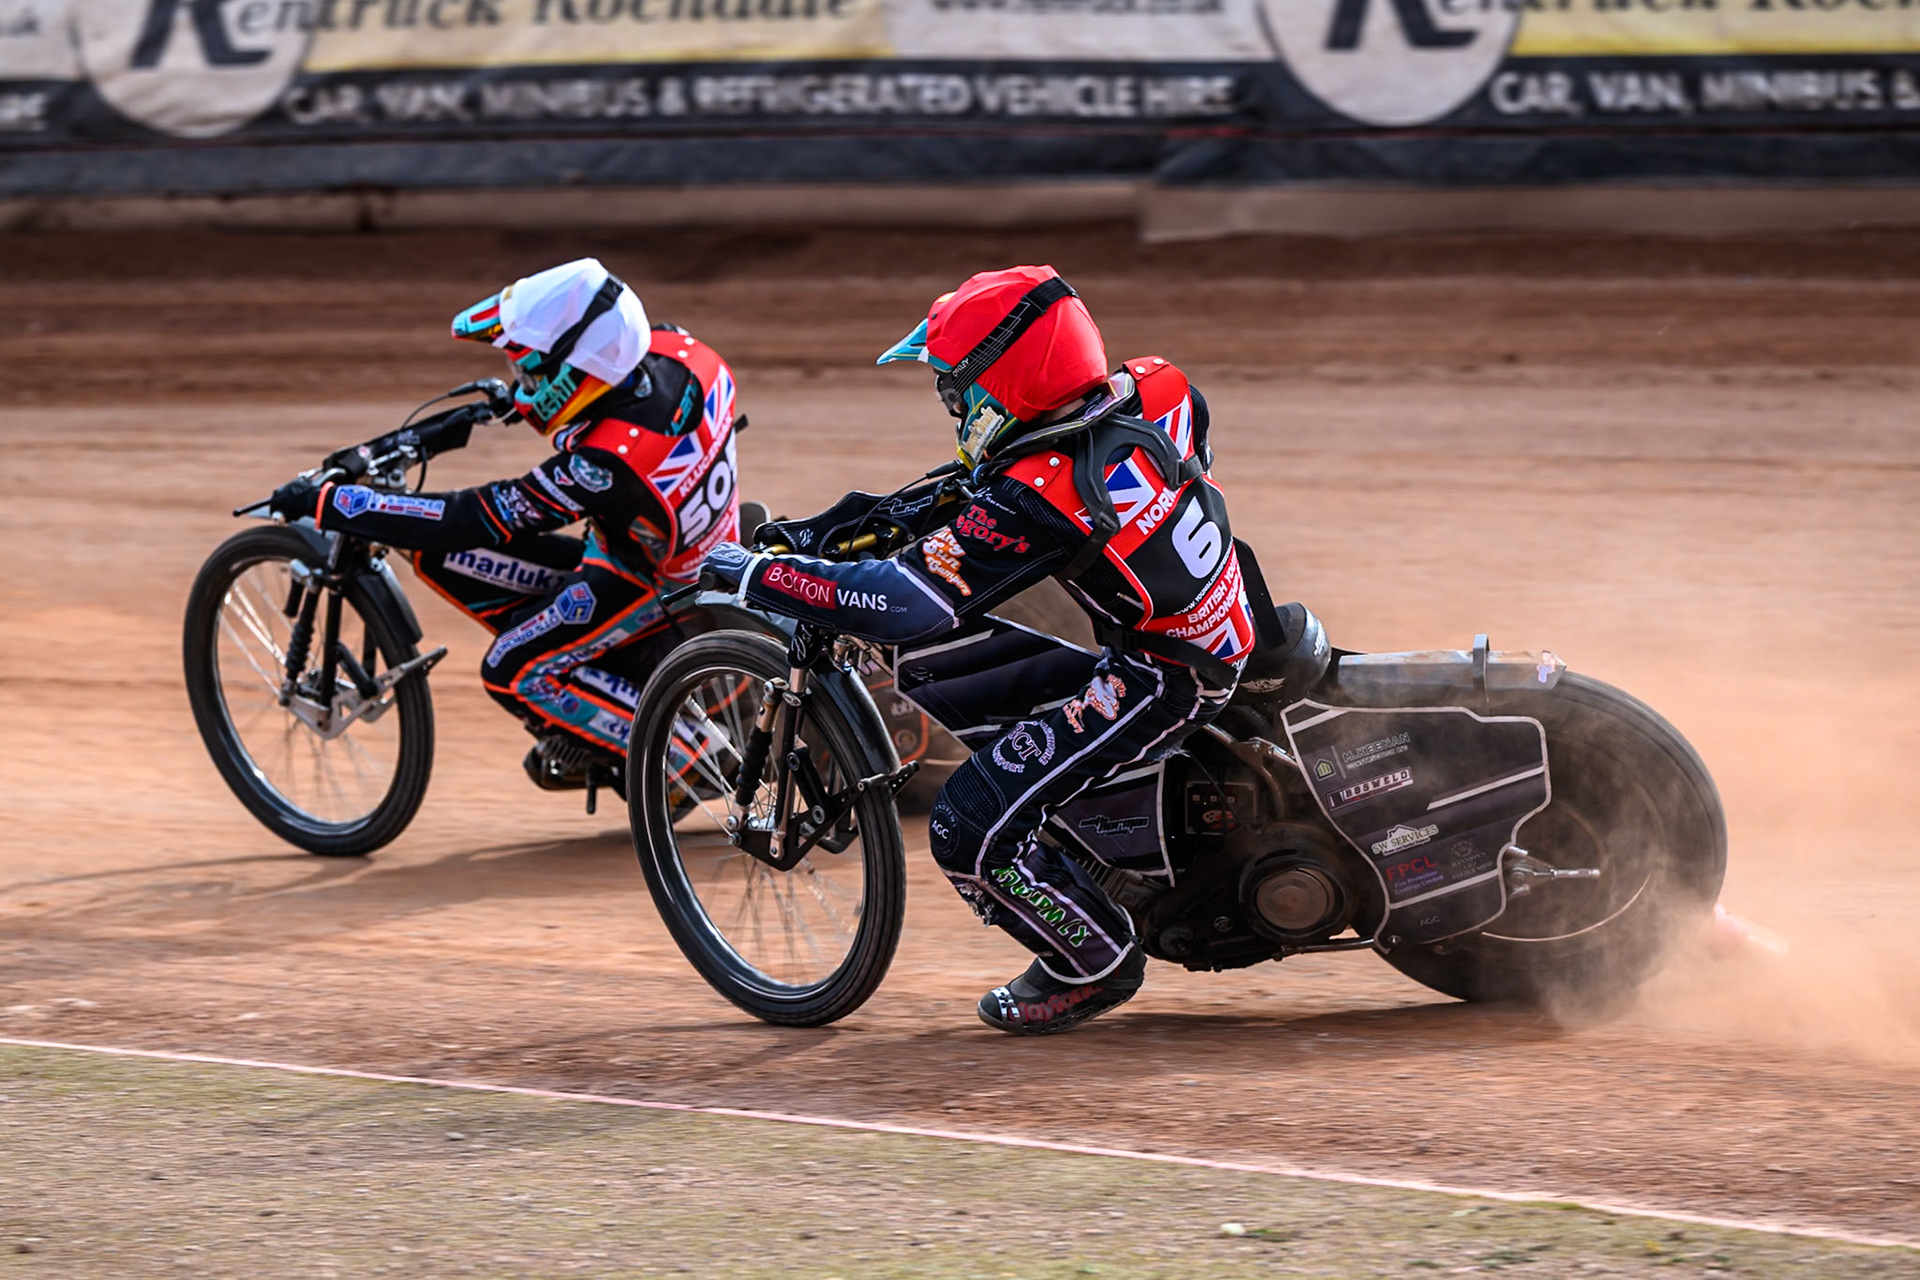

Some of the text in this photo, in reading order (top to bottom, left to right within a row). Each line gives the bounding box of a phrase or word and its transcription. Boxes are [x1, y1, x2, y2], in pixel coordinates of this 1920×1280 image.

[482, 78, 649, 119] MINIBUS
[656, 77, 686, 117] &
[692, 74, 969, 117] REFRIGERATED
[977, 74, 1133, 117] VEHICLE
[1142, 76, 1234, 115] HIRE
[1491, 71, 1582, 116] CAR,
[1704, 69, 1881, 111] MINIBUS
[968, 504, 999, 530] The
[1135, 486, 1181, 536] NORM
[955, 514, 1032, 554] egory's
[1171, 495, 1223, 579] 6
[768, 566, 831, 603] BOLTON
[836, 588, 888, 612] VANS
[1187, 550, 1242, 625] BRITISH YOU
[1342, 732, 1411, 763] M.KEENAN
[931, 820, 949, 840] AGC
[1372, 839, 1389, 855] SW
[1389, 825, 1438, 848] SERVICES
[1384, 855, 1439, 882] FPCL
[1419, 914, 1441, 927] AGC
